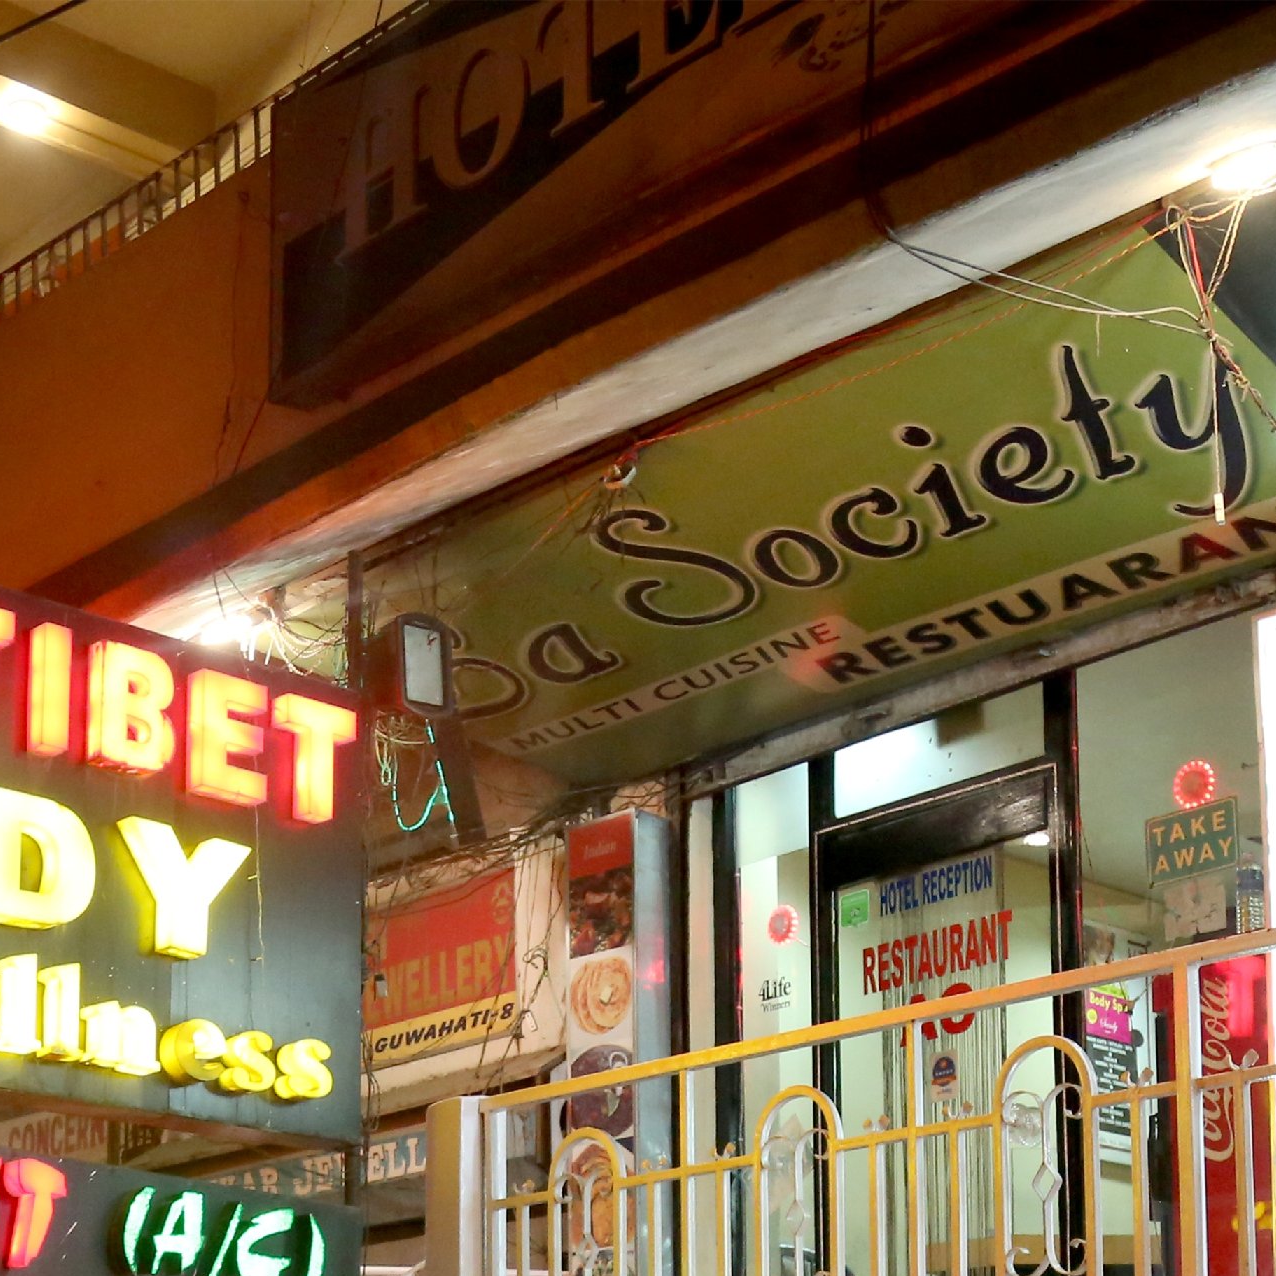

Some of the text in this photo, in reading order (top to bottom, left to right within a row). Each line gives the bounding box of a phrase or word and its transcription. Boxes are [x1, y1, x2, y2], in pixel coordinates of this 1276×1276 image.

[591, 343, 1250, 629] Society
[505, 618, 844, 752] MULTI CUISINE
[1151, 809, 1227, 848] TAKE
[1154, 836, 1233, 875] AWAY
[879, 875, 919, 918] HOTEL
[922, 855, 993, 905] RECEPTION
[862, 910, 1013, 995] RESTAURANT
[758, 976, 792, 1003] 4Life
[1089, 991, 1110, 1010] Body
[374, 1002, 515, 1054] GUWAHATI-8
